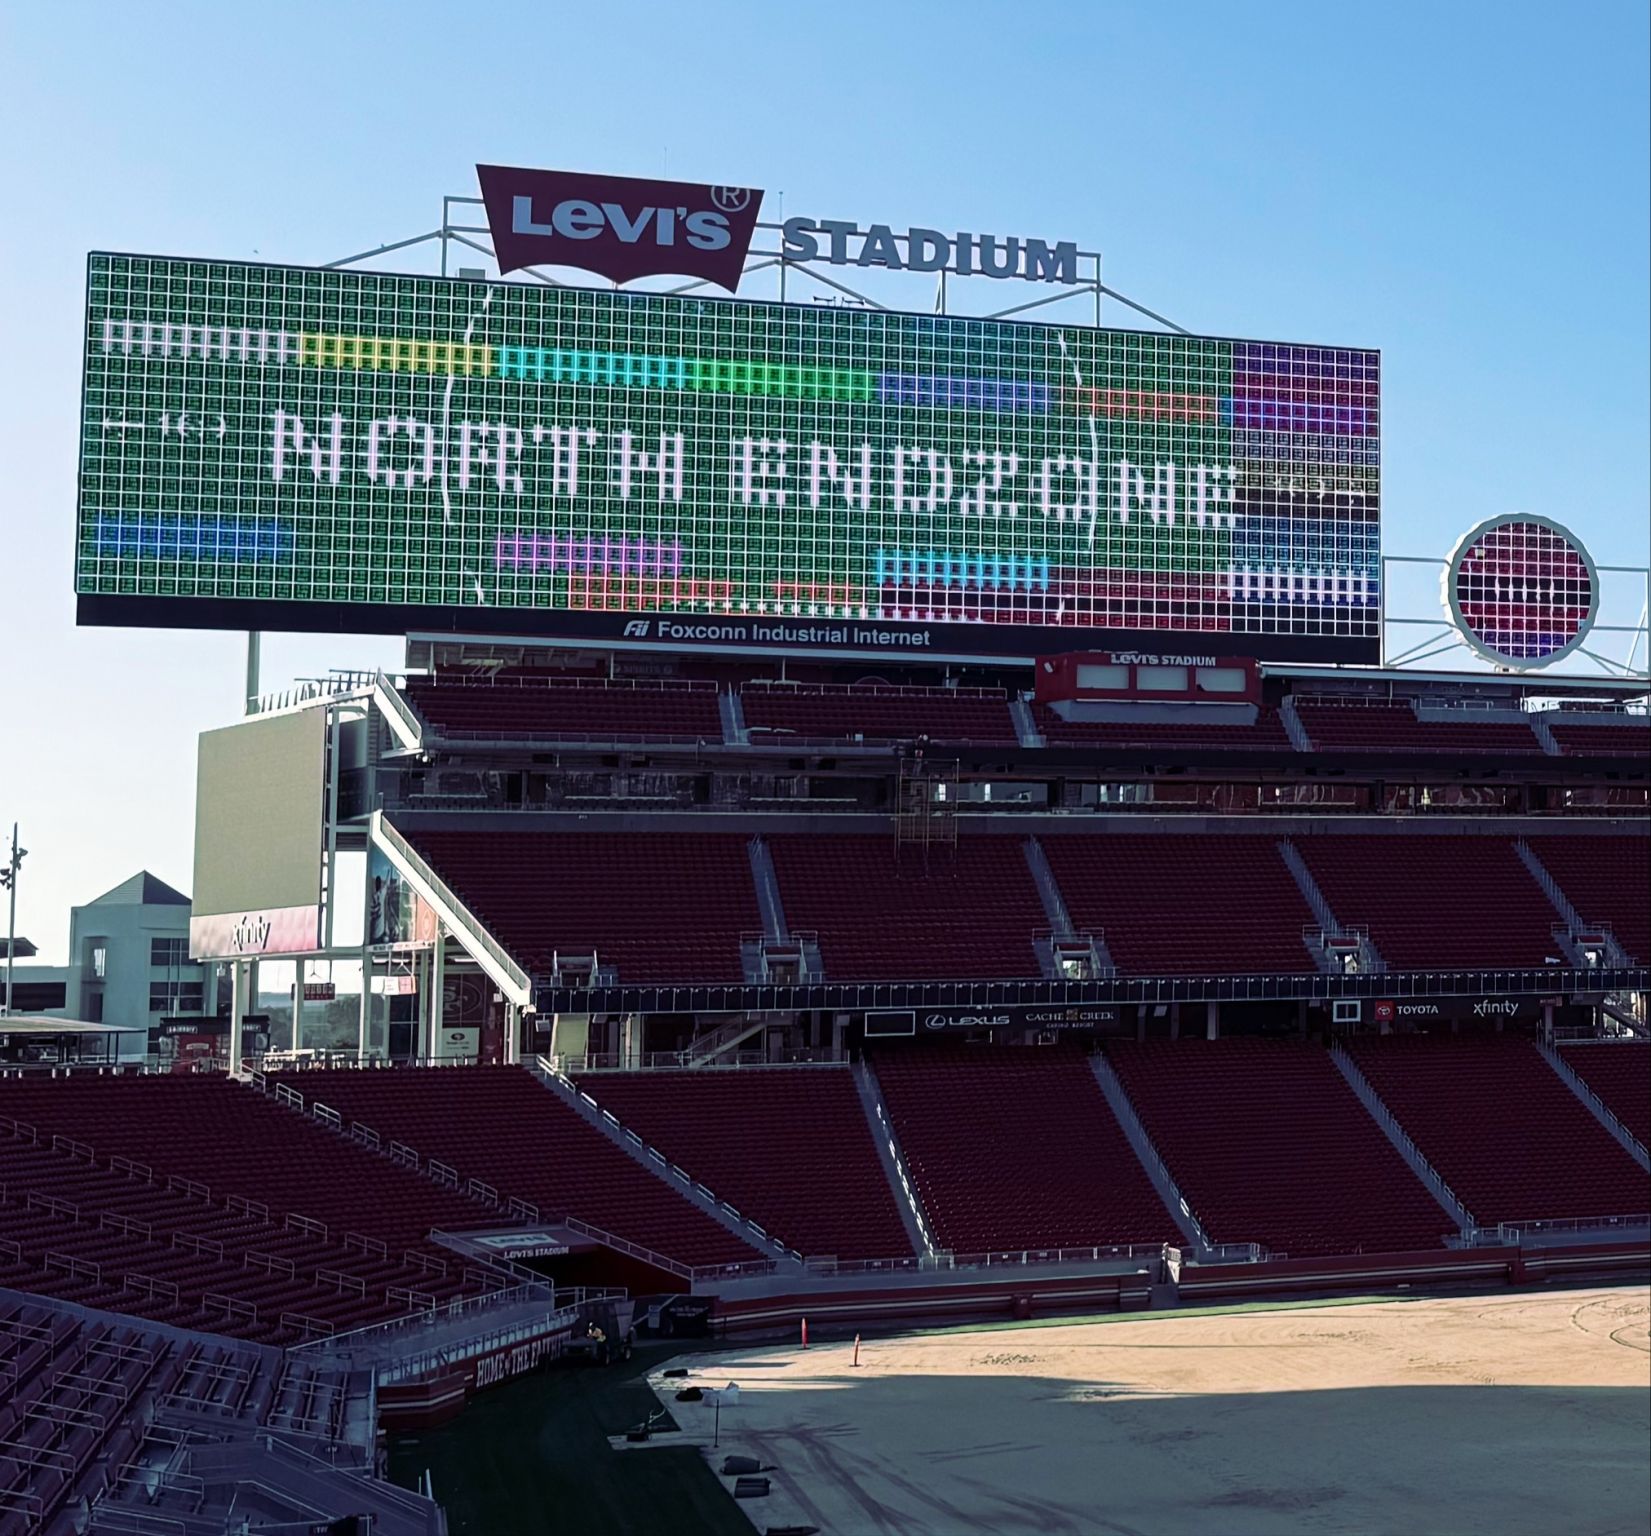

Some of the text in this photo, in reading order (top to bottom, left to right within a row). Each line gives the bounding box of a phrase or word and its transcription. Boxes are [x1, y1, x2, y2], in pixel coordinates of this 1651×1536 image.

[781, 216, 1078, 284] STADIUM
[270, 408, 684, 501] NORTH
[658, 623, 746, 640] Foxconn
[753, 624, 847, 643] Industrial
[854, 629, 931, 646] Internet
[1161, 655, 1217, 667] STADIUM
[1025, 1012, 1064, 1021] CACHE
[1397, 1004, 1439, 1015] TOYOTA
[1473, 1000, 1519, 1017] xfinity
[948, 1015, 1010, 1026] LEXUS
[475, 1352, 505, 1388] HOME
[511, 1344, 531, 1375] THE
